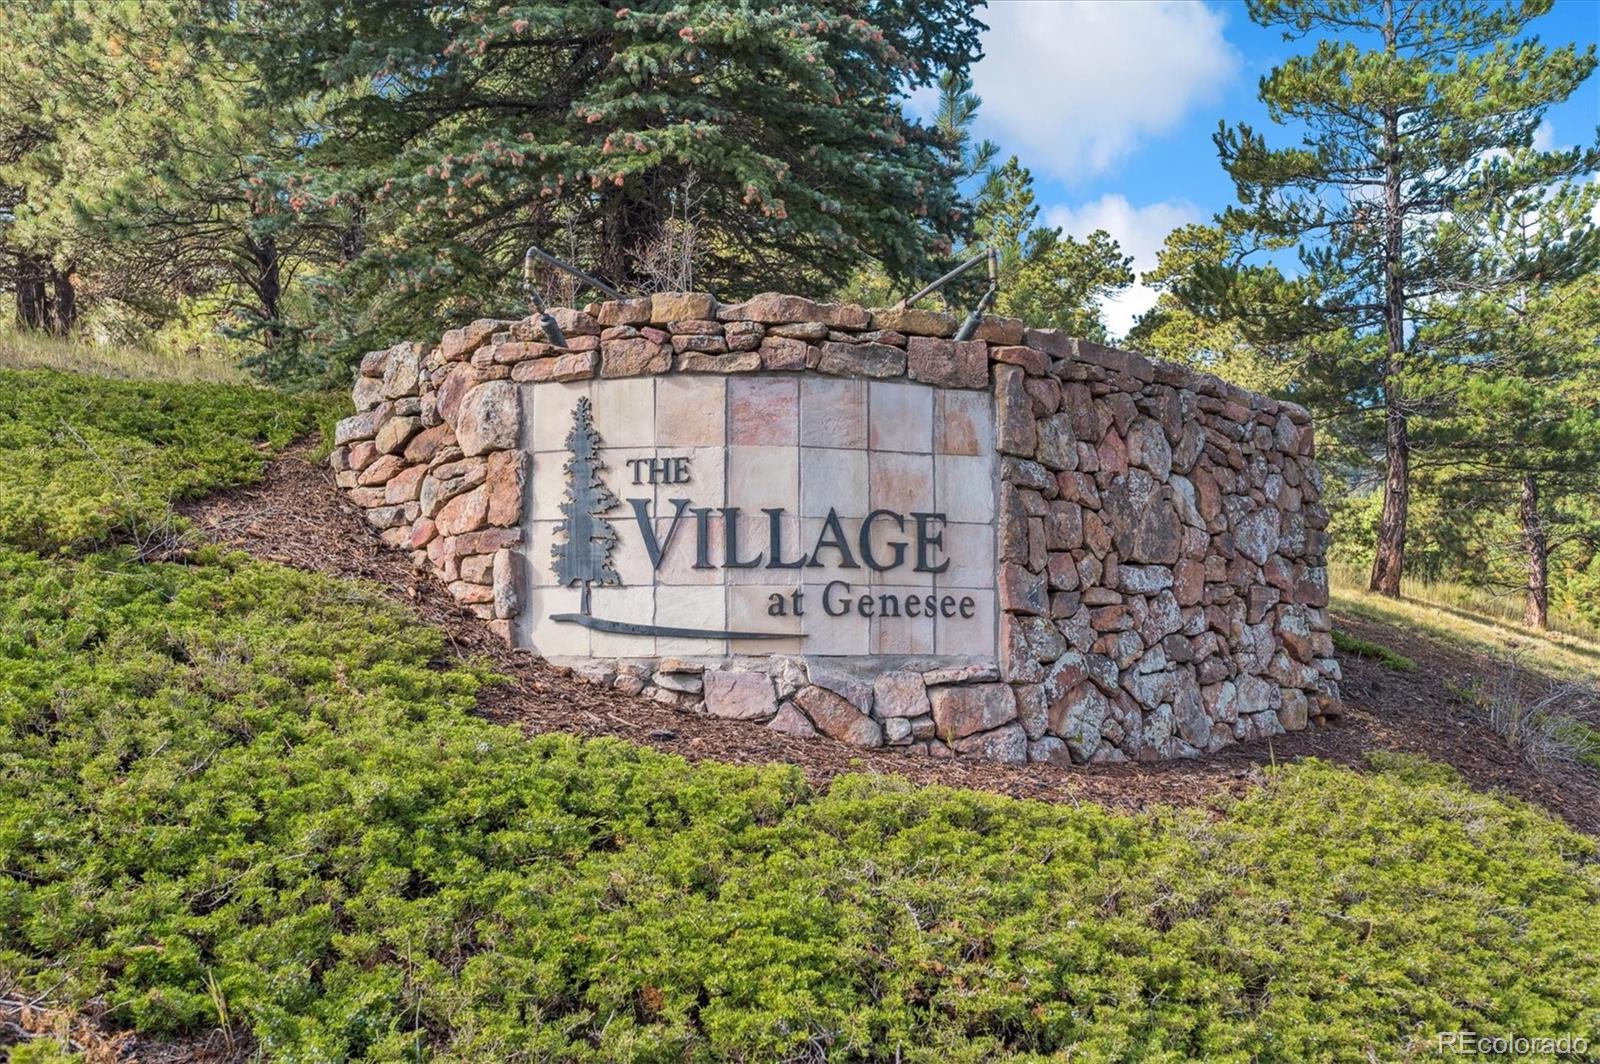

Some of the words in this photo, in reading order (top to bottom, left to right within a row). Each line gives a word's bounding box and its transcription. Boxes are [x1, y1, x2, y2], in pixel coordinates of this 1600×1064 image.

[626, 457, 690, 485] THE
[626, 498, 951, 573] VILLAGE
[768, 591, 804, 617] at
[822, 580, 976, 619] Genesee
